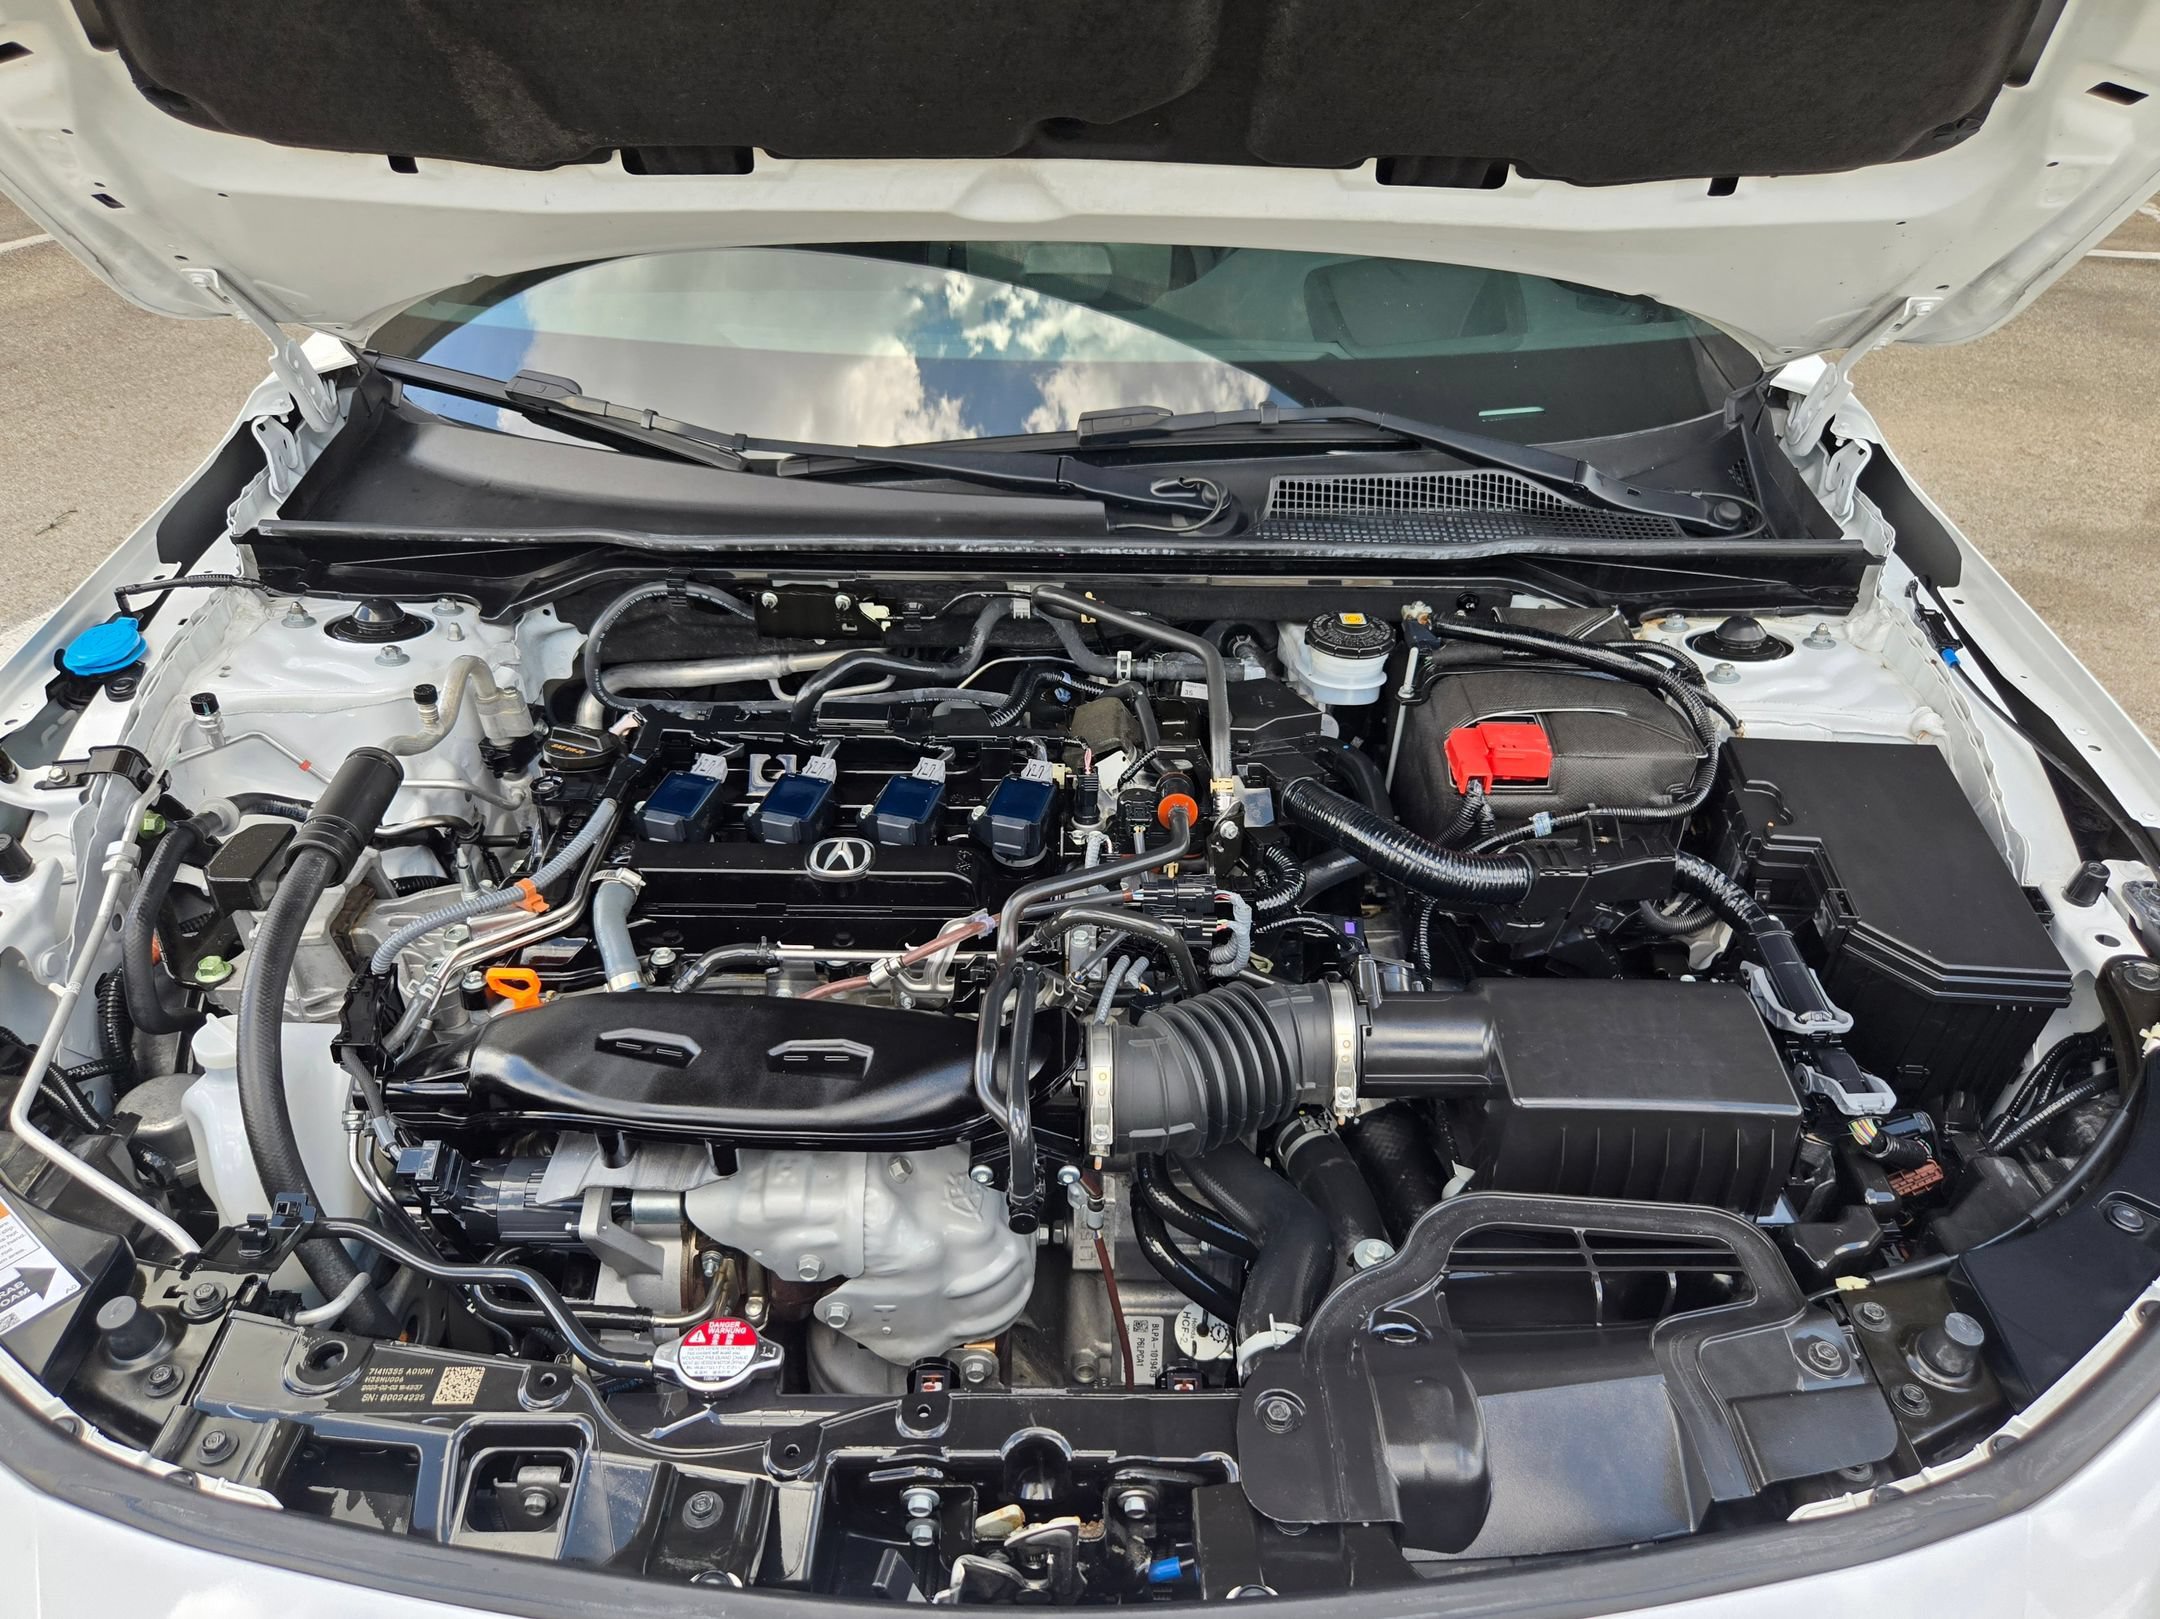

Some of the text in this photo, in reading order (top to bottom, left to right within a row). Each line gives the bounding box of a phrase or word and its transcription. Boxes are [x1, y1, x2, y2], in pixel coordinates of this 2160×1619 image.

[707, 1327, 747, 1335] WARNUNG
[1180, 1311, 1191, 1345] HCF-2
[1190, 1317, 1198, 1339] Honda
